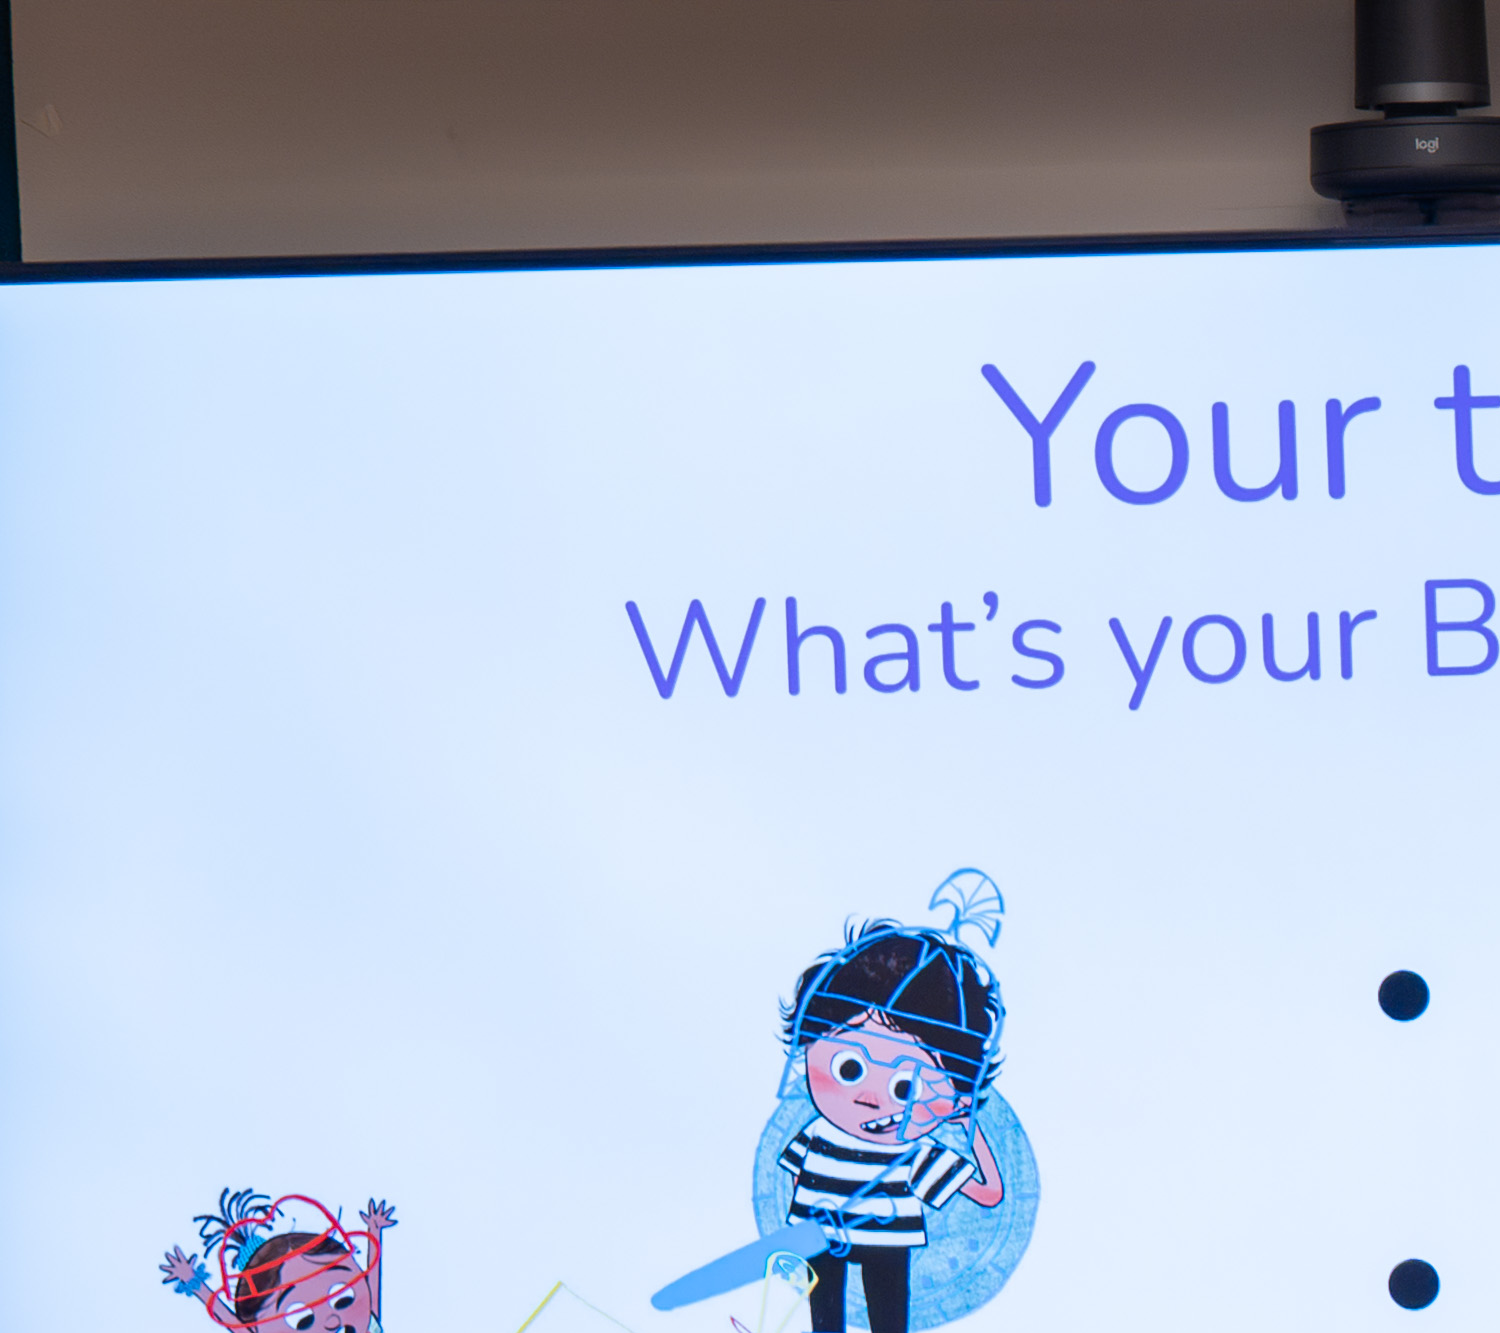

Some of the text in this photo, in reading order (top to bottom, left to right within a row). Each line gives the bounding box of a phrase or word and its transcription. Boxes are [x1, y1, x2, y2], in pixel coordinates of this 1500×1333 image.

[1415, 138, 1440, 154] logi
[980, 360, 1382, 508] Your
[1108, 609, 1378, 711] your
